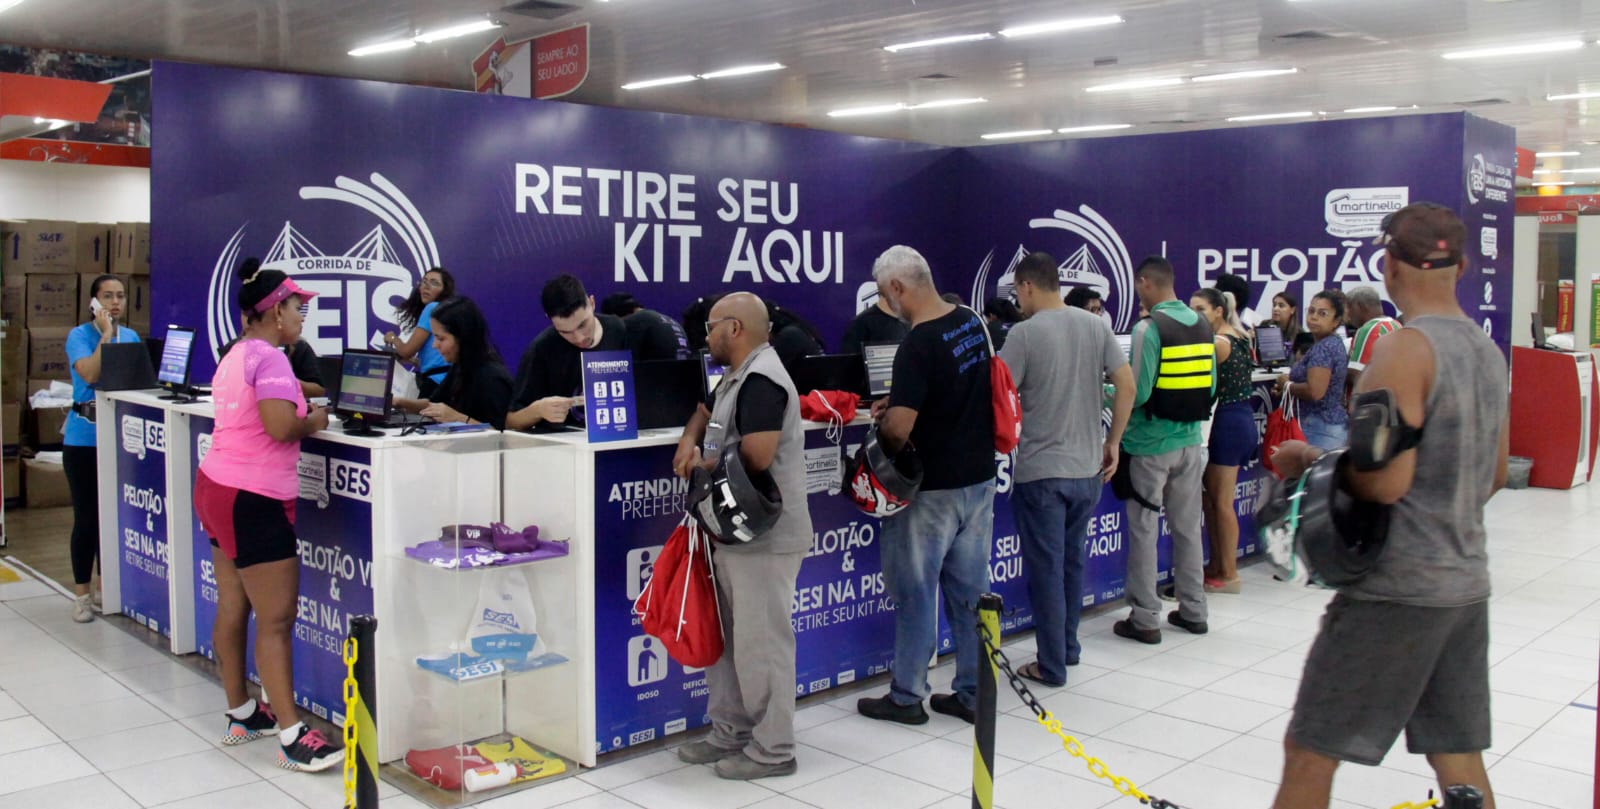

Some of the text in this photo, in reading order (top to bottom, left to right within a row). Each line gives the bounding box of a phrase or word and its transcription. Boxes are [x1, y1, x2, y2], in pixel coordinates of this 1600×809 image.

[537, 44, 579, 64] SEMPRE AO
[537, 62, 578, 80] SEU LADO!
[515, 163, 798, 225] RETIRE SEU
[1340, 200, 1402, 211] martinello
[297, 259, 371, 270] CORRIDA DE
[614, 222, 844, 284] KIT AQUI
[1067, 271, 1079, 279] DE
[297, 279, 413, 357] EIS
[149, 425, 166, 448] SE
[335, 464, 371, 496] SES
[608, 477, 690, 503] ATENDIM
[123, 483, 162, 515] PELOTÃO
[622, 494, 689, 520] PREFERE
[146, 512, 154, 532] &
[1100, 512, 1120, 534] SEU
[125, 527, 169, 564] SESI NA PIS
[807, 521, 874, 557] LOTÃO
[996, 534, 1020, 558] SEU
[1089, 532, 1122, 558] AQUI
[144, 558, 155, 575] SEU
[841, 551, 855, 572] &
[330, 577, 341, 601] &
[828, 579, 856, 606] NA
[861, 572, 885, 598] PIS
[320, 603, 343, 635] NA
[791, 611, 830, 633] RETIRE
[833, 604, 854, 624] SEU
[858, 600, 875, 618] KIT
[295, 622, 324, 649] RETIRE
[325, 634, 343, 656] SEU
[637, 689, 660, 702] IDOSO
[811, 680, 830, 691] SESI
[632, 730, 653, 743] SESI
